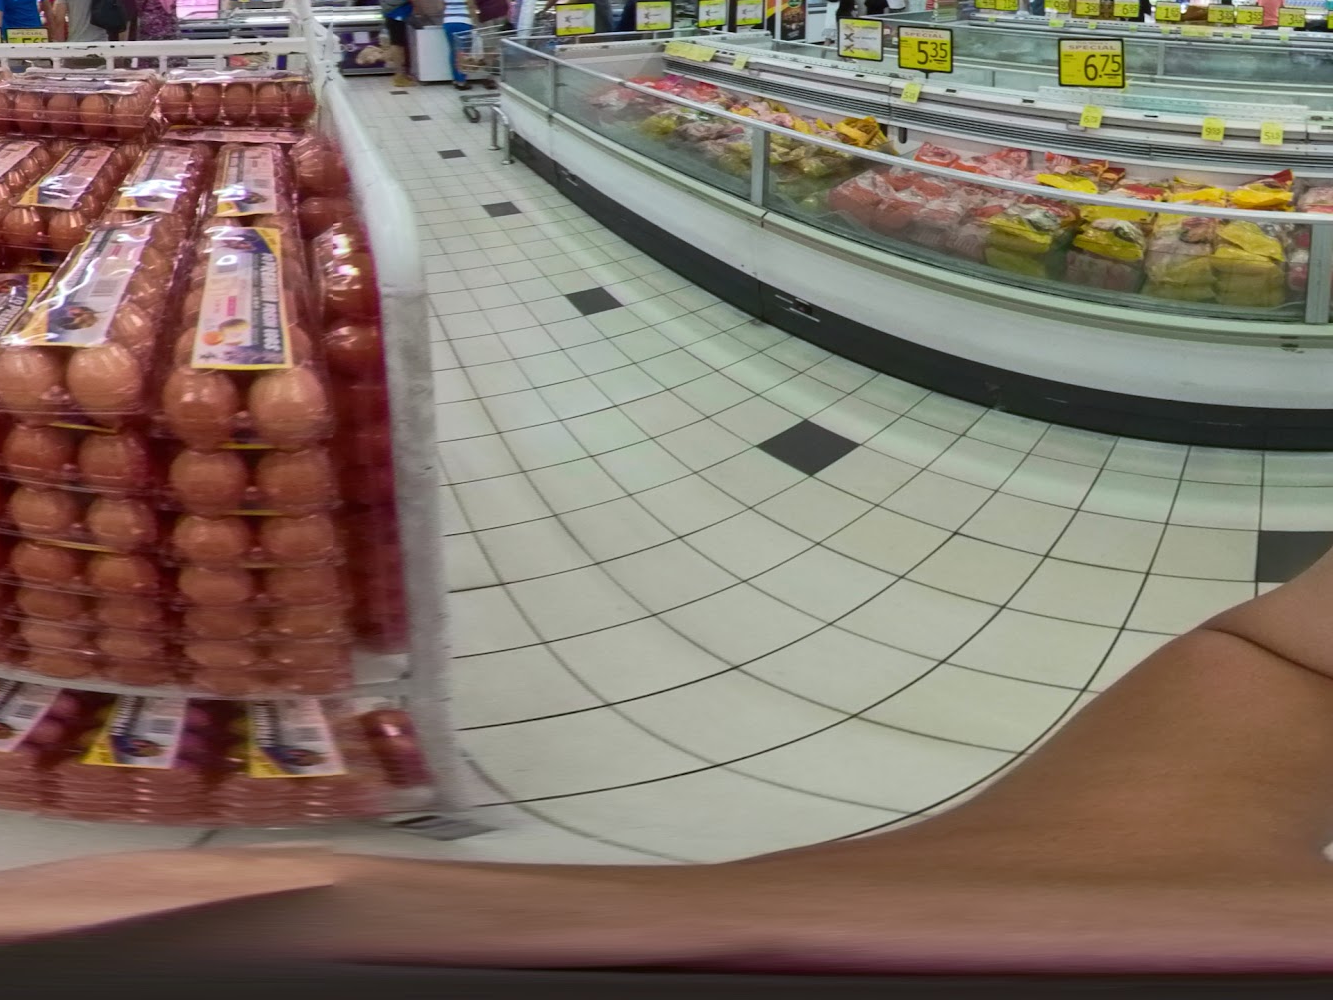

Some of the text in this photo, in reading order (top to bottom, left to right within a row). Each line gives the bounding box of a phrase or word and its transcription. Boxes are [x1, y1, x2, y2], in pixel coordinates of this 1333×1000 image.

[904, 31, 944, 39] SPECIAL
[917, 40, 948, 65] 5.35
[1068, 43, 1117, 51] SPECIAL
[1083, 53, 1122, 81] 6.75
